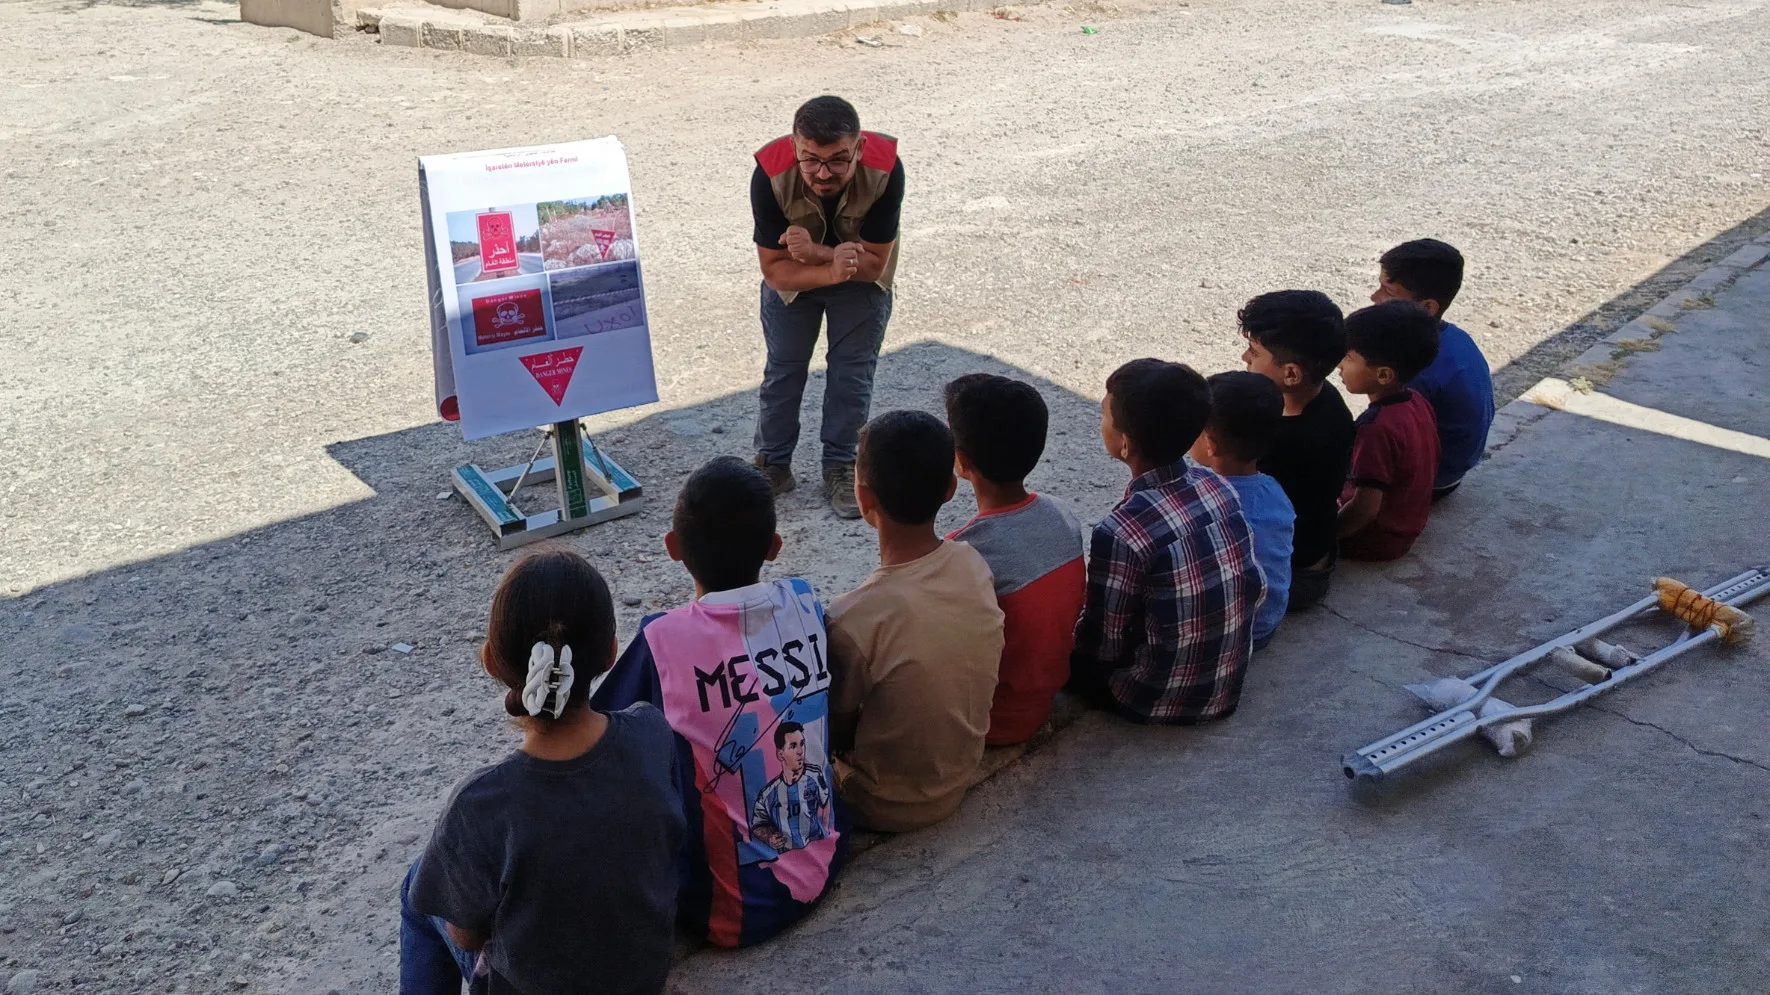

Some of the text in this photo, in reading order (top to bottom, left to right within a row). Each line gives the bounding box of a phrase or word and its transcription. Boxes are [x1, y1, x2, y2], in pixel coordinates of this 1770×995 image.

[535, 367, 573, 379] DANGER MINES
[694, 633, 829, 713] MESSI
